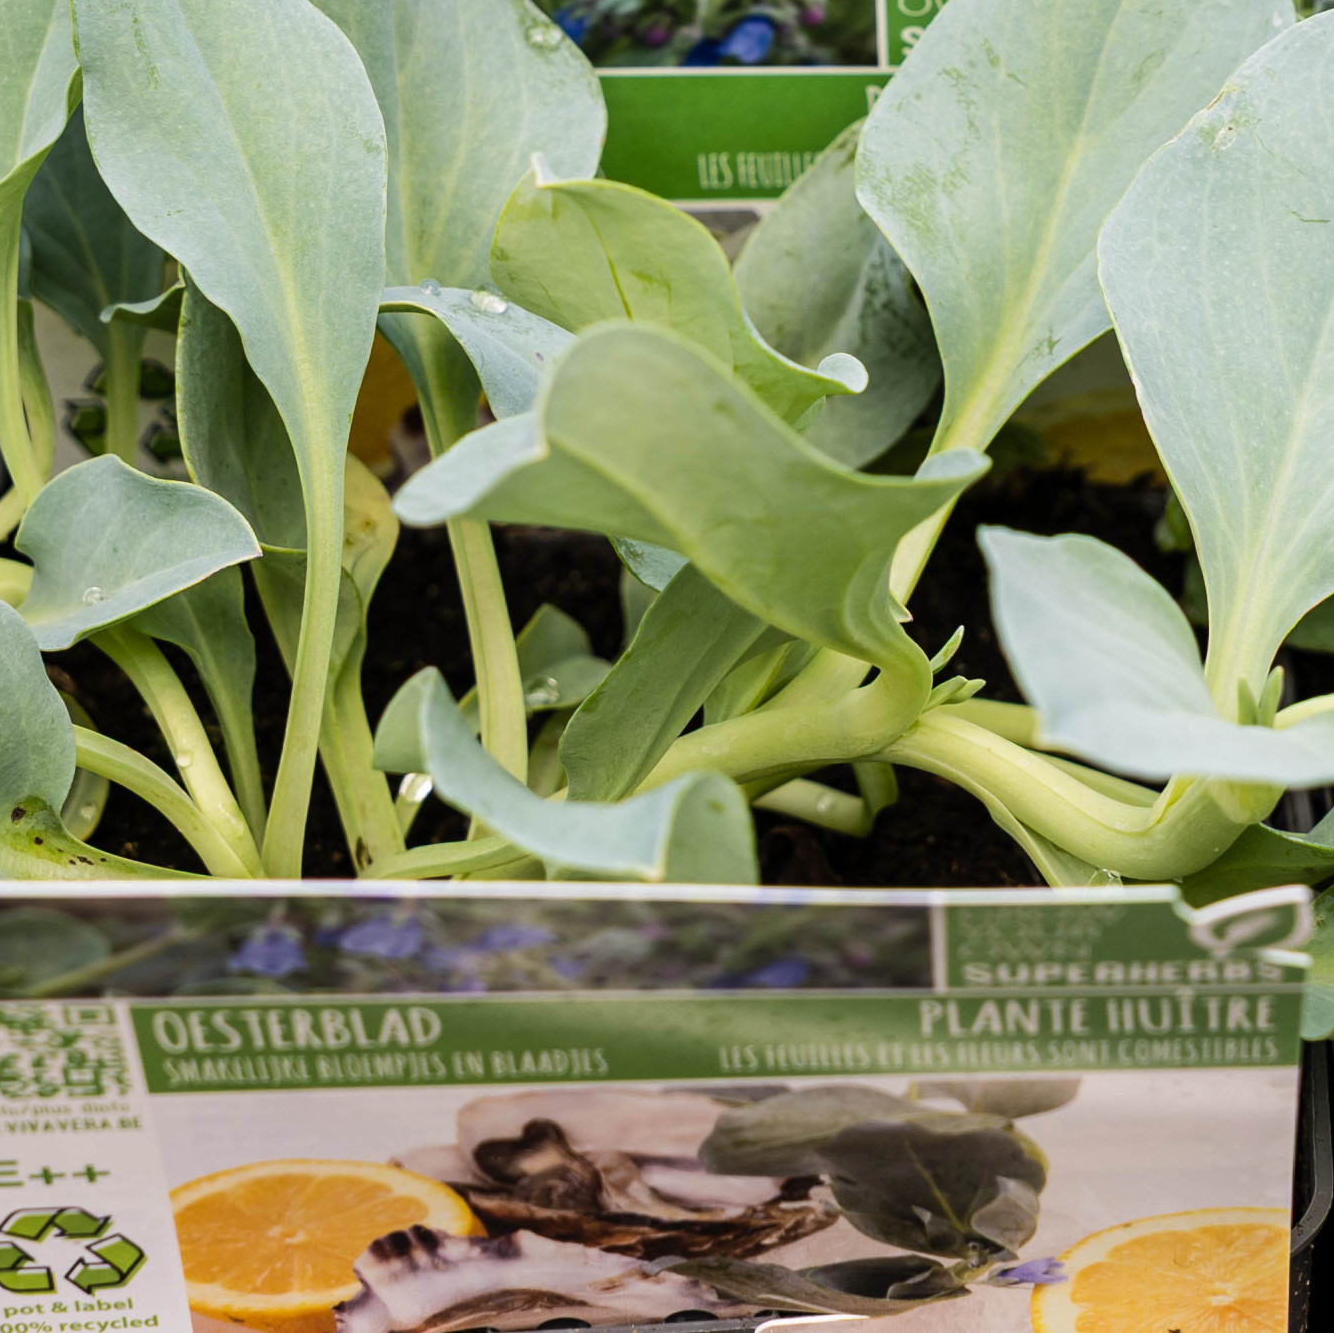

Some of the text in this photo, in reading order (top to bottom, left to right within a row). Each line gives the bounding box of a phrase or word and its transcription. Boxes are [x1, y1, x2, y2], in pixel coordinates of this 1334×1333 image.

[697, 152, 733, 189] LES
[964, 959, 1284, 985] SUPERHERBS
[152, 1006, 442, 1053] OESTERBLAD
[919, 987, 1278, 1038] PLANTE HUÎTRE
[165, 1048, 609, 1085] SMAKELIJKE BLOEMPJES EN BLAADJES
[3, 1298, 134, 1319] pot & label
[59, 1315, 159, 1333] recycled
